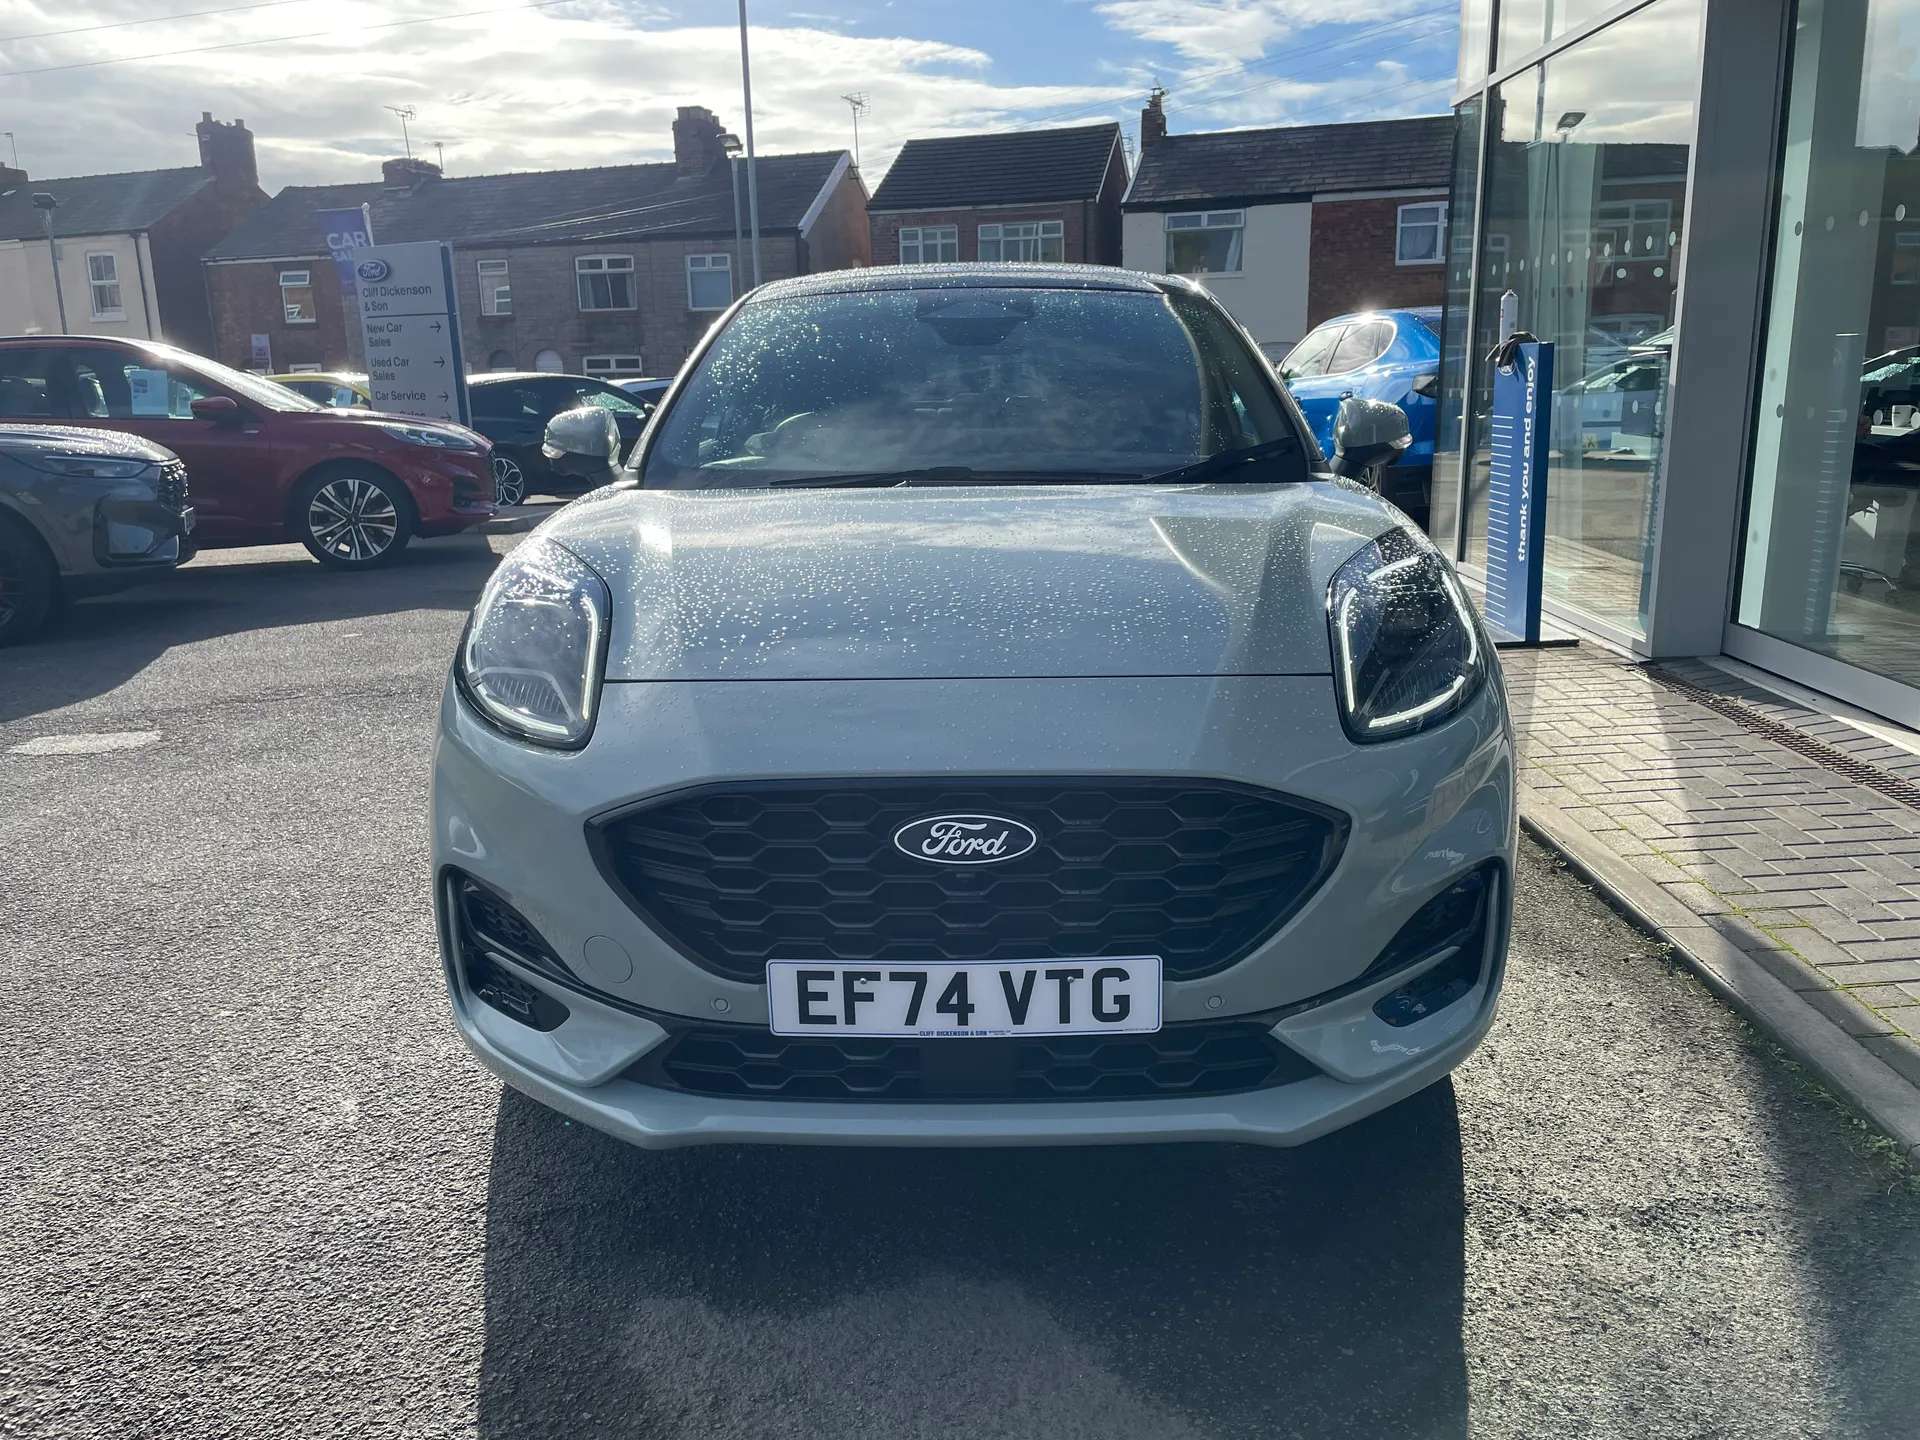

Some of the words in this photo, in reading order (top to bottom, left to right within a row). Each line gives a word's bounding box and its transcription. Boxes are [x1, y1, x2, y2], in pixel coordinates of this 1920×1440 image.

[326, 231, 367, 249] CAR
[332, 249, 352, 261] SAL
[362, 287, 378, 298] Cliff
[380, 286, 432, 297] Dickenson
[364, 302, 370, 312] &
[371, 301, 388, 312] Son
[367, 323, 385, 334] New
[386, 322, 402, 333] Car
[368, 337, 392, 347] Sales
[370, 357, 392, 367] Used
[393, 356, 409, 367] Car
[372, 370, 396, 380] Sales
[1525, 356, 1536, 414] enjoy
[375, 391, 389, 401] Car
[390, 390, 427, 401] Service
[1523, 417, 1532, 458] and
[1522, 462, 1530, 499] you
[1518, 503, 1528, 562] thank
[921, 821, 1010, 856] Ford
[796, 970, 975, 1026] EF74
[999, 967, 1131, 1025] VTG
